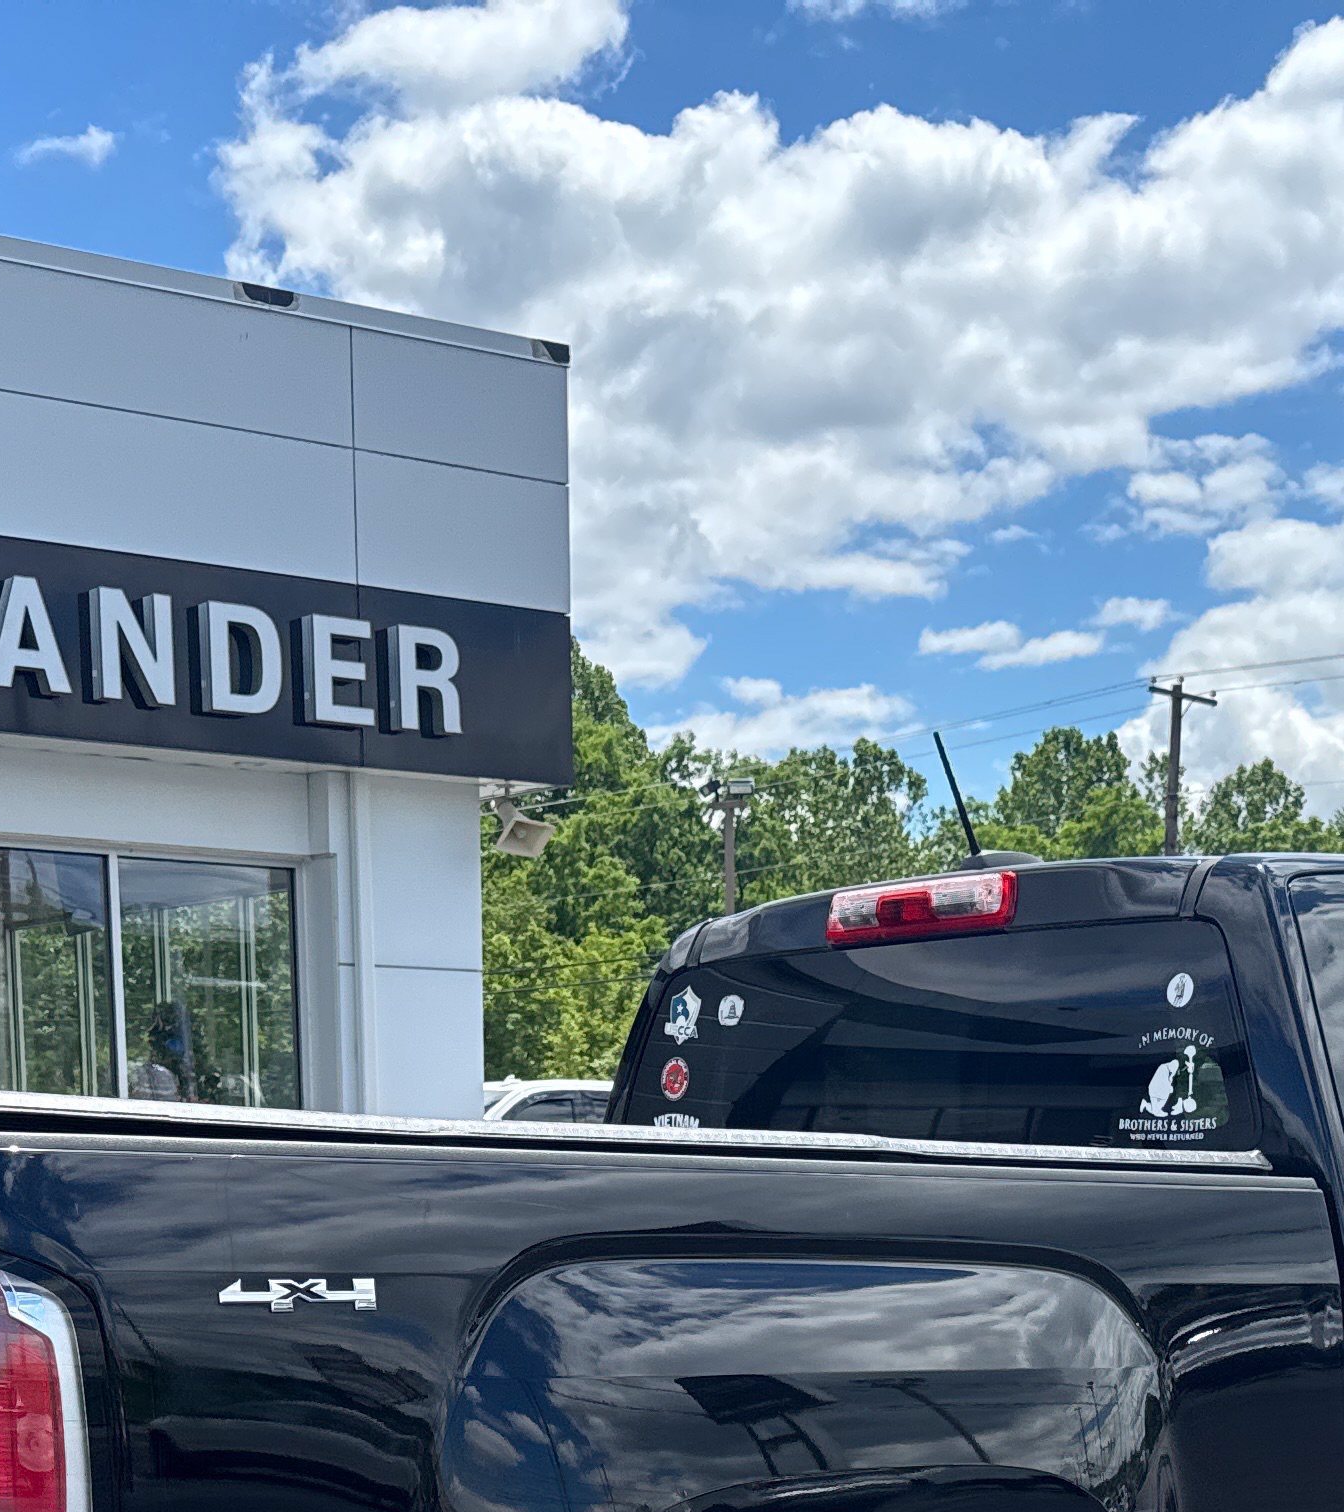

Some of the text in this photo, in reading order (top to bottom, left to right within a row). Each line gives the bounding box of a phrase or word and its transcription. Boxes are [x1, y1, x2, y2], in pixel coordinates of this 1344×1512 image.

[664, 1022, 699, 1039] USCCA
[1153, 1026, 1199, 1041] MEMORY
[1199, 1033, 1214, 1048] OF
[653, 1113, 700, 1128] VIETNAM
[1119, 1116, 1217, 1131] BROTHERS & SISTERS
[1147, 1133, 1167, 1141] NEVER
[1169, 1132, 1204, 1141] RETURNED
